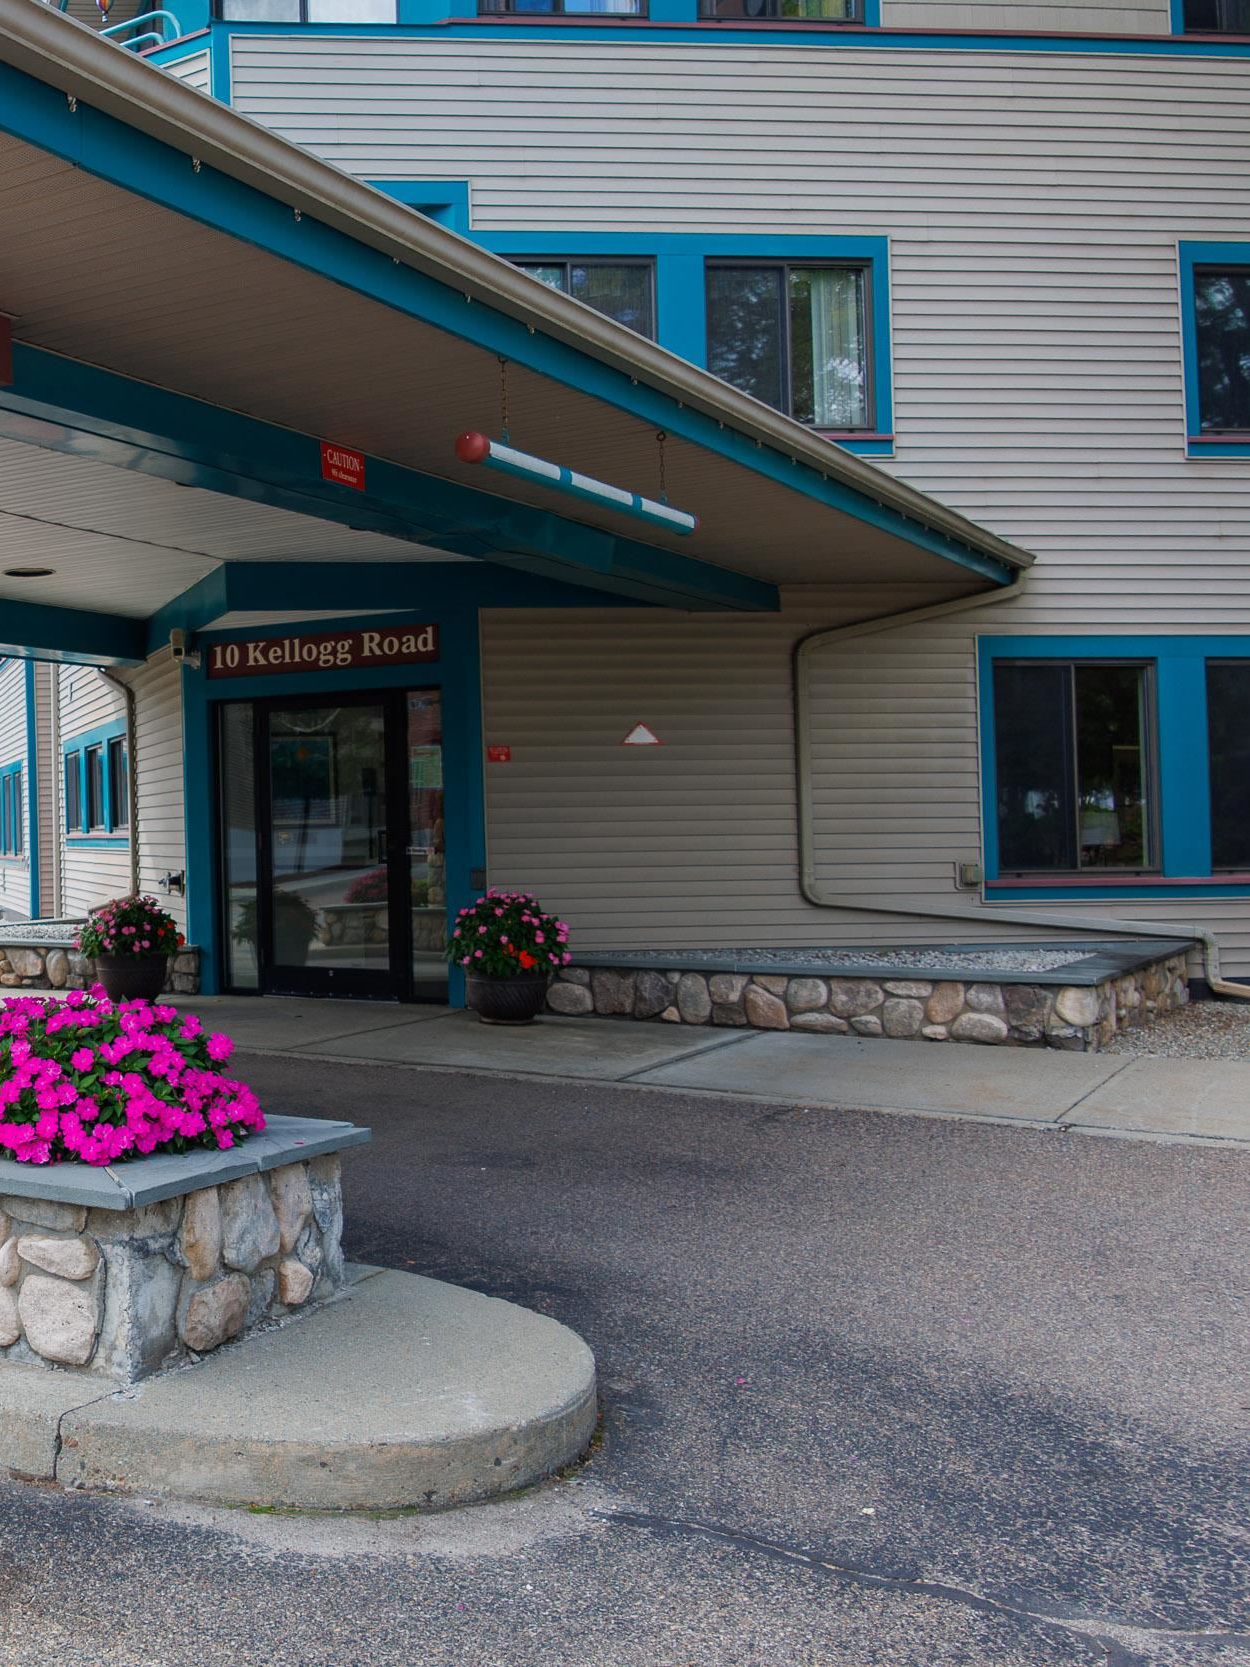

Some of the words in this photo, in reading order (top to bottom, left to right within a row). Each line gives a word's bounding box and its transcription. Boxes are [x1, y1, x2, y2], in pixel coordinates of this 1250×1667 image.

[327, 449, 359, 471] CAUTION
[213, 644, 240, 669] 10
[246, 638, 353, 667] Kellogg
[361, 626, 435, 657] Road
